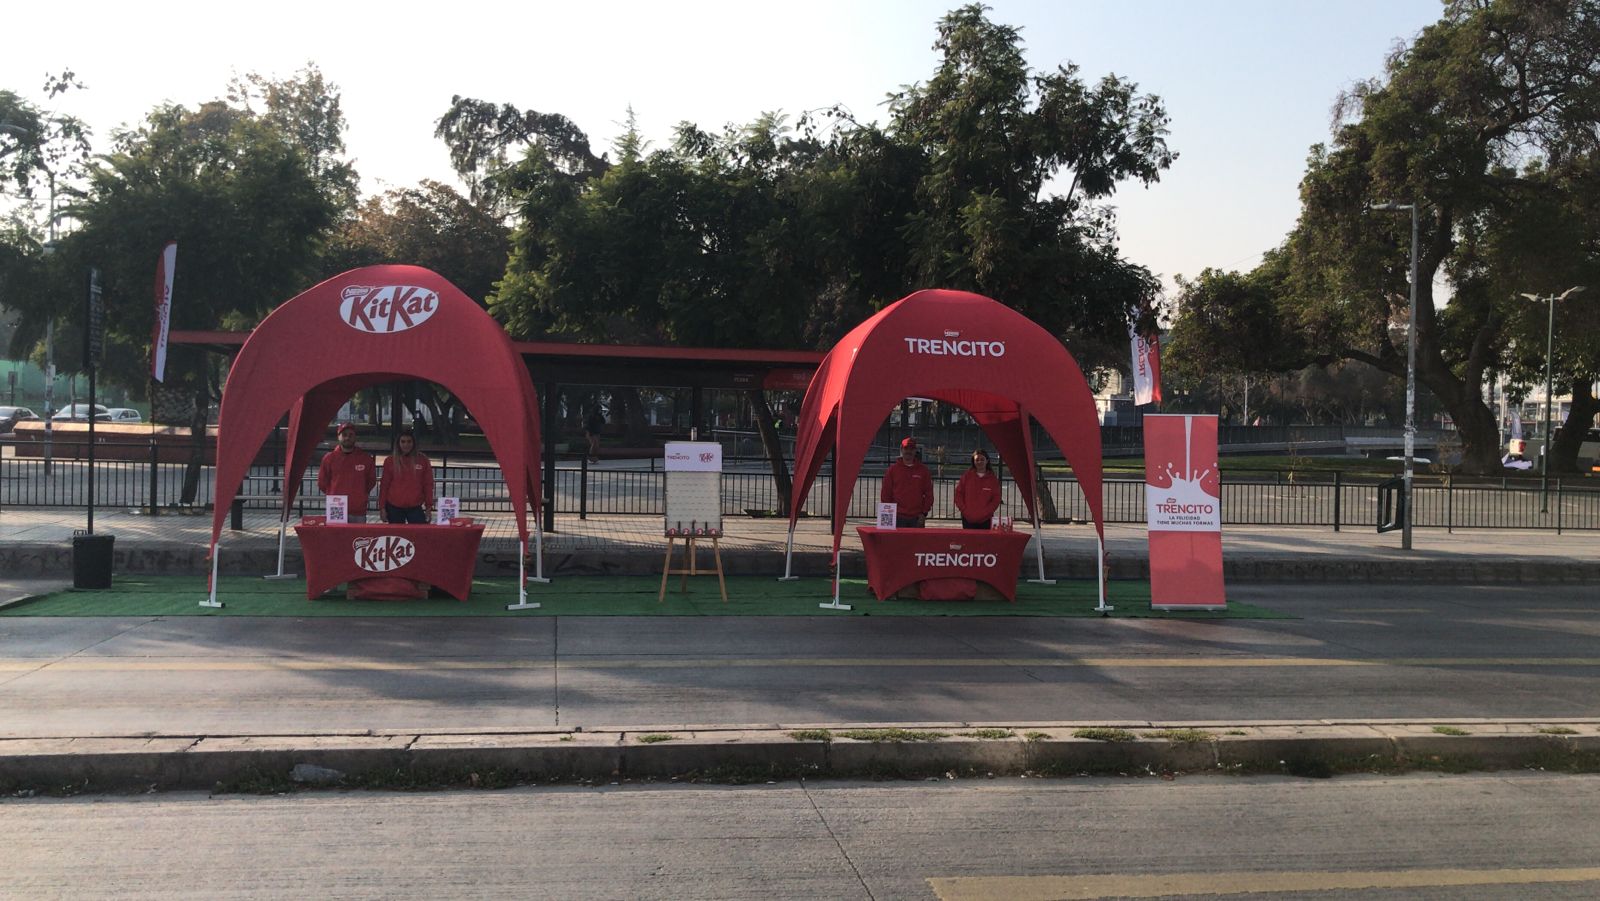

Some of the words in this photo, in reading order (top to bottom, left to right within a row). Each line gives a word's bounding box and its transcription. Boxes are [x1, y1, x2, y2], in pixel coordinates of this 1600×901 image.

[348, 286, 436, 332] KitKat
[904, 337, 1005, 357] TRENCITO
[1156, 504, 1213, 514] TRENCITO
[361, 536, 413, 571] KitKat
[914, 553, 997, 568] TRENCITO
